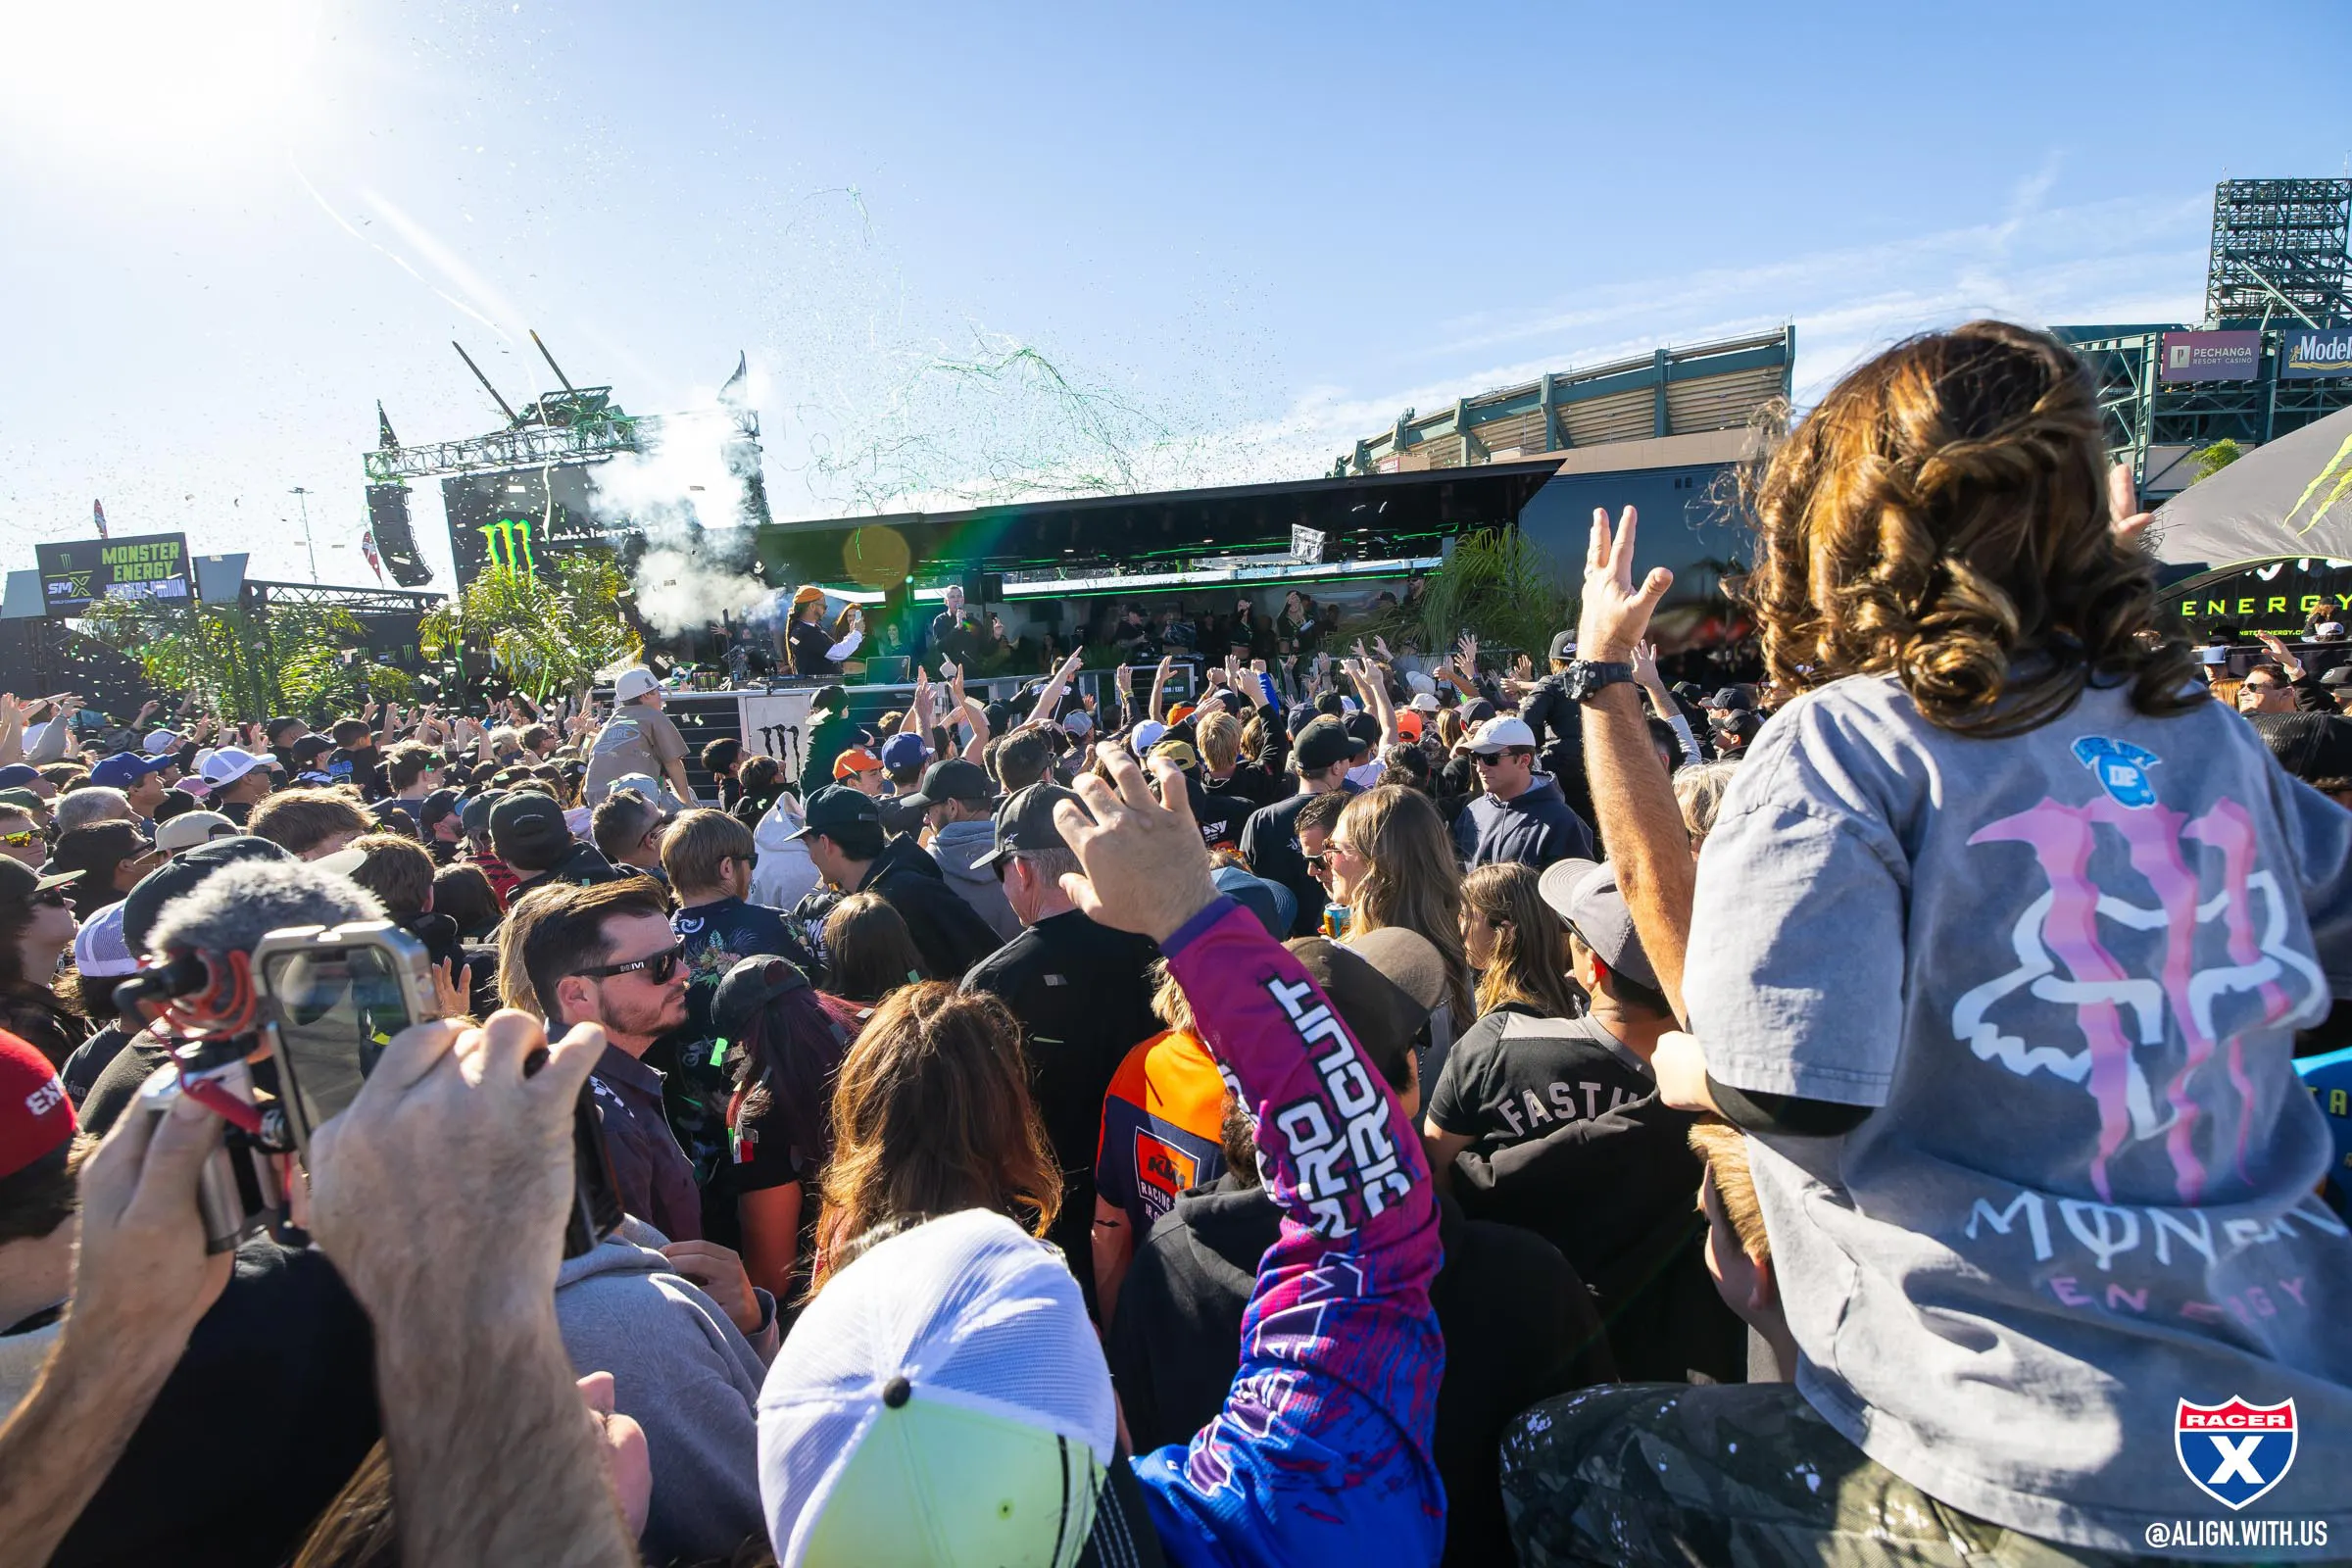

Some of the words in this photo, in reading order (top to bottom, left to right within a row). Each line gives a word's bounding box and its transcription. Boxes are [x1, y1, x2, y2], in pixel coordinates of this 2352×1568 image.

[2193, 347, 2252, 358] PECHANGA
[2299, 335, 2352, 361] Model
[101, 541, 179, 564] MONSTER
[113, 561, 174, 582] ENERGY
[48, 575, 91, 598] SMX
[2181, 593, 2352, 616] ENERGY
[1268, 978, 1412, 1218] CIRCUIT
[1141, 1181, 1171, 1211] RACING
